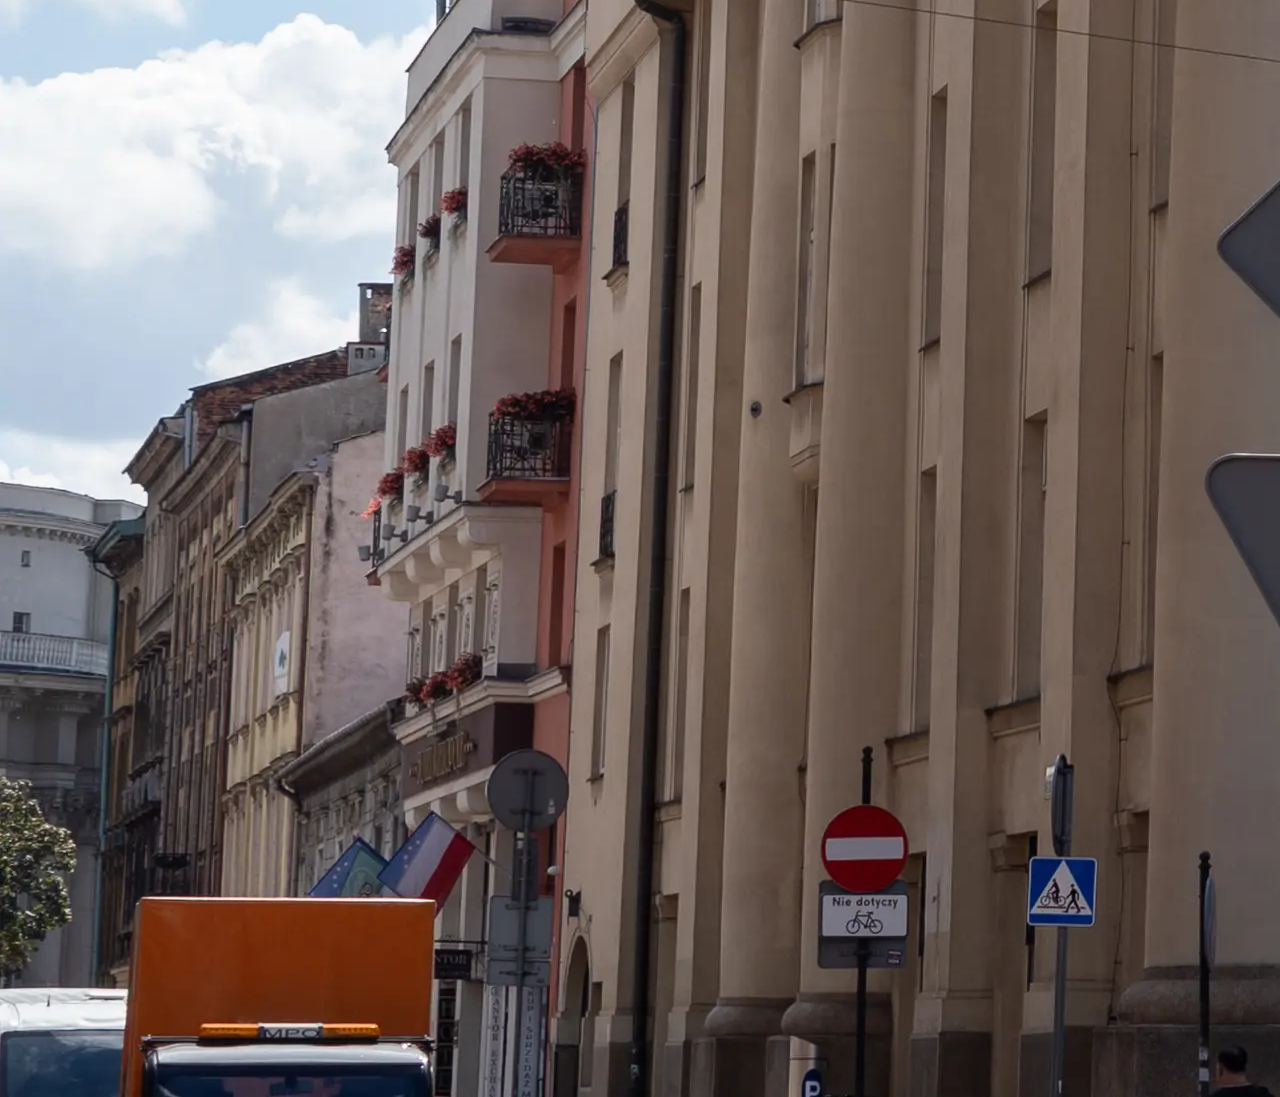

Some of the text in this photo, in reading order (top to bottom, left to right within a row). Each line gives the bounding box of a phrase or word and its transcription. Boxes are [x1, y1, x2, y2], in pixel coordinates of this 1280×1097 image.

[832, 897, 898, 909] Nie dotyczy
[436, 953, 467, 965] NTOR
[263, 1028, 320, 1039] MPO
